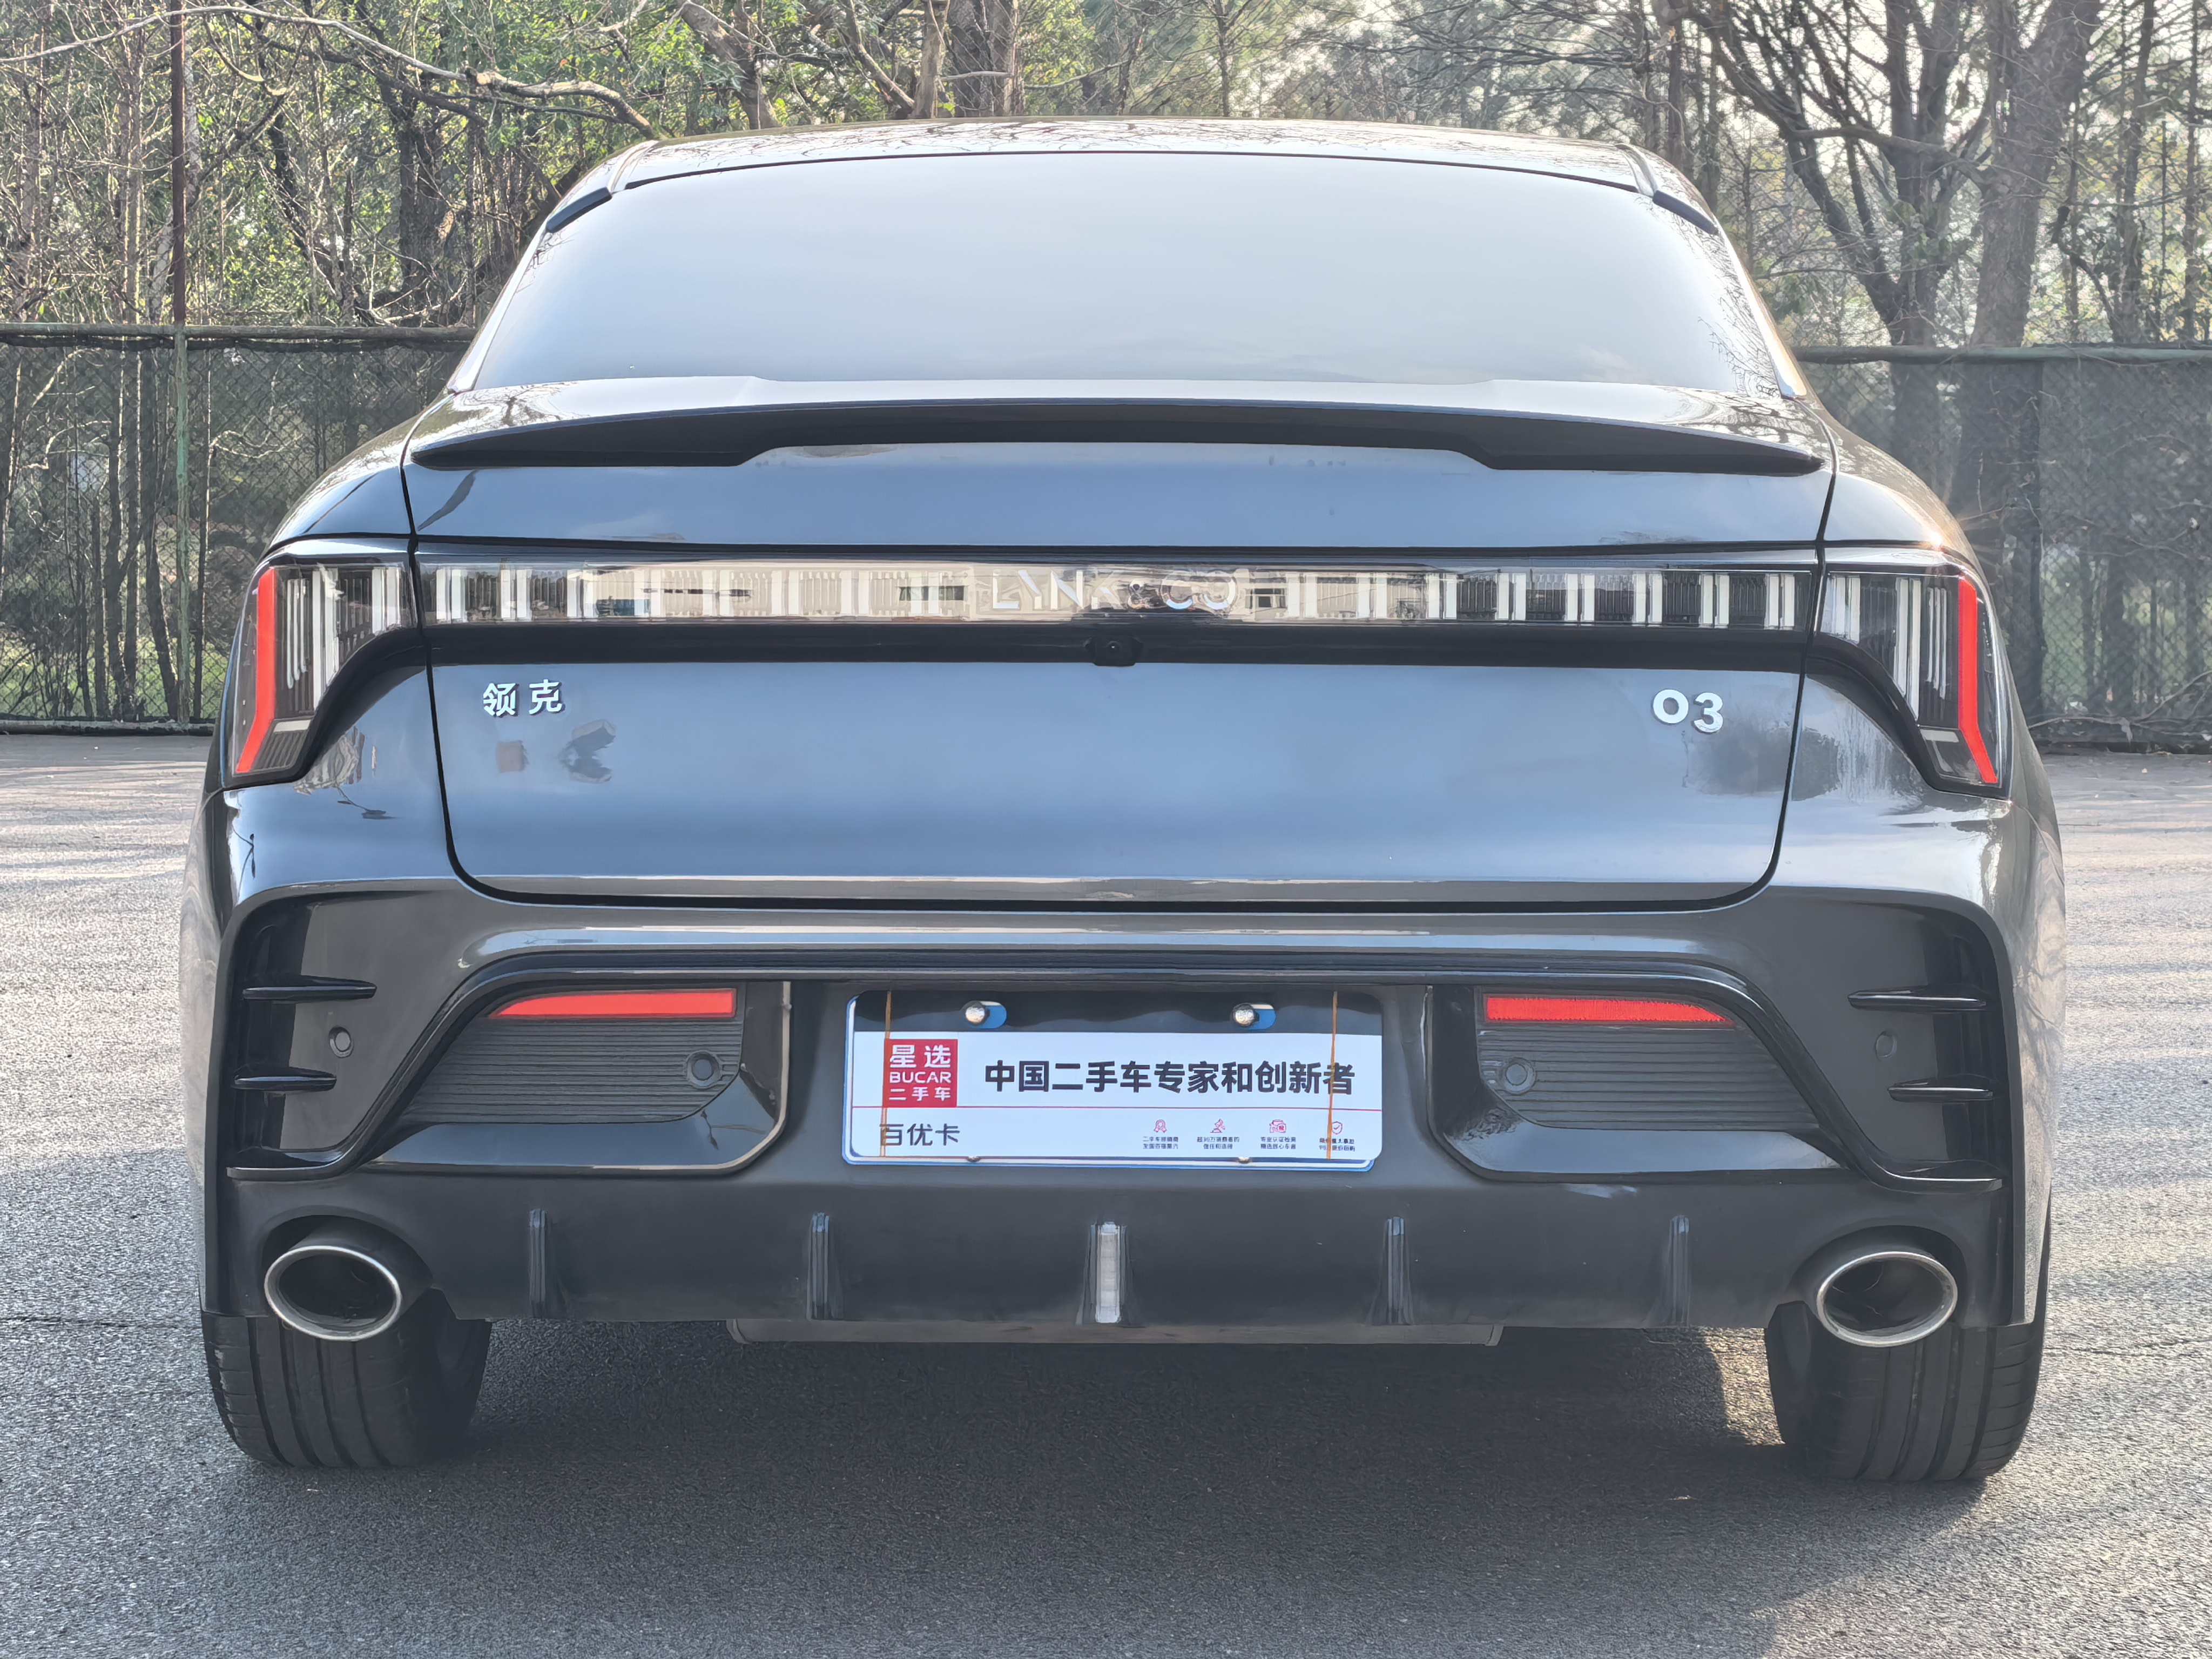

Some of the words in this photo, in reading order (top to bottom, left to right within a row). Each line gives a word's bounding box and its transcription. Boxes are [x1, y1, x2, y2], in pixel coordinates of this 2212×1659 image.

[483, 679, 565, 718] 领克
[889, 1044, 951, 1068] 星选
[889, 1071, 951, 1083] BUCAR
[985, 1060, 1355, 1095] 中国二手车专家和创新者
[889, 1087, 950, 1101] 二手车
[880, 1123, 960, 1145] 百优卡
